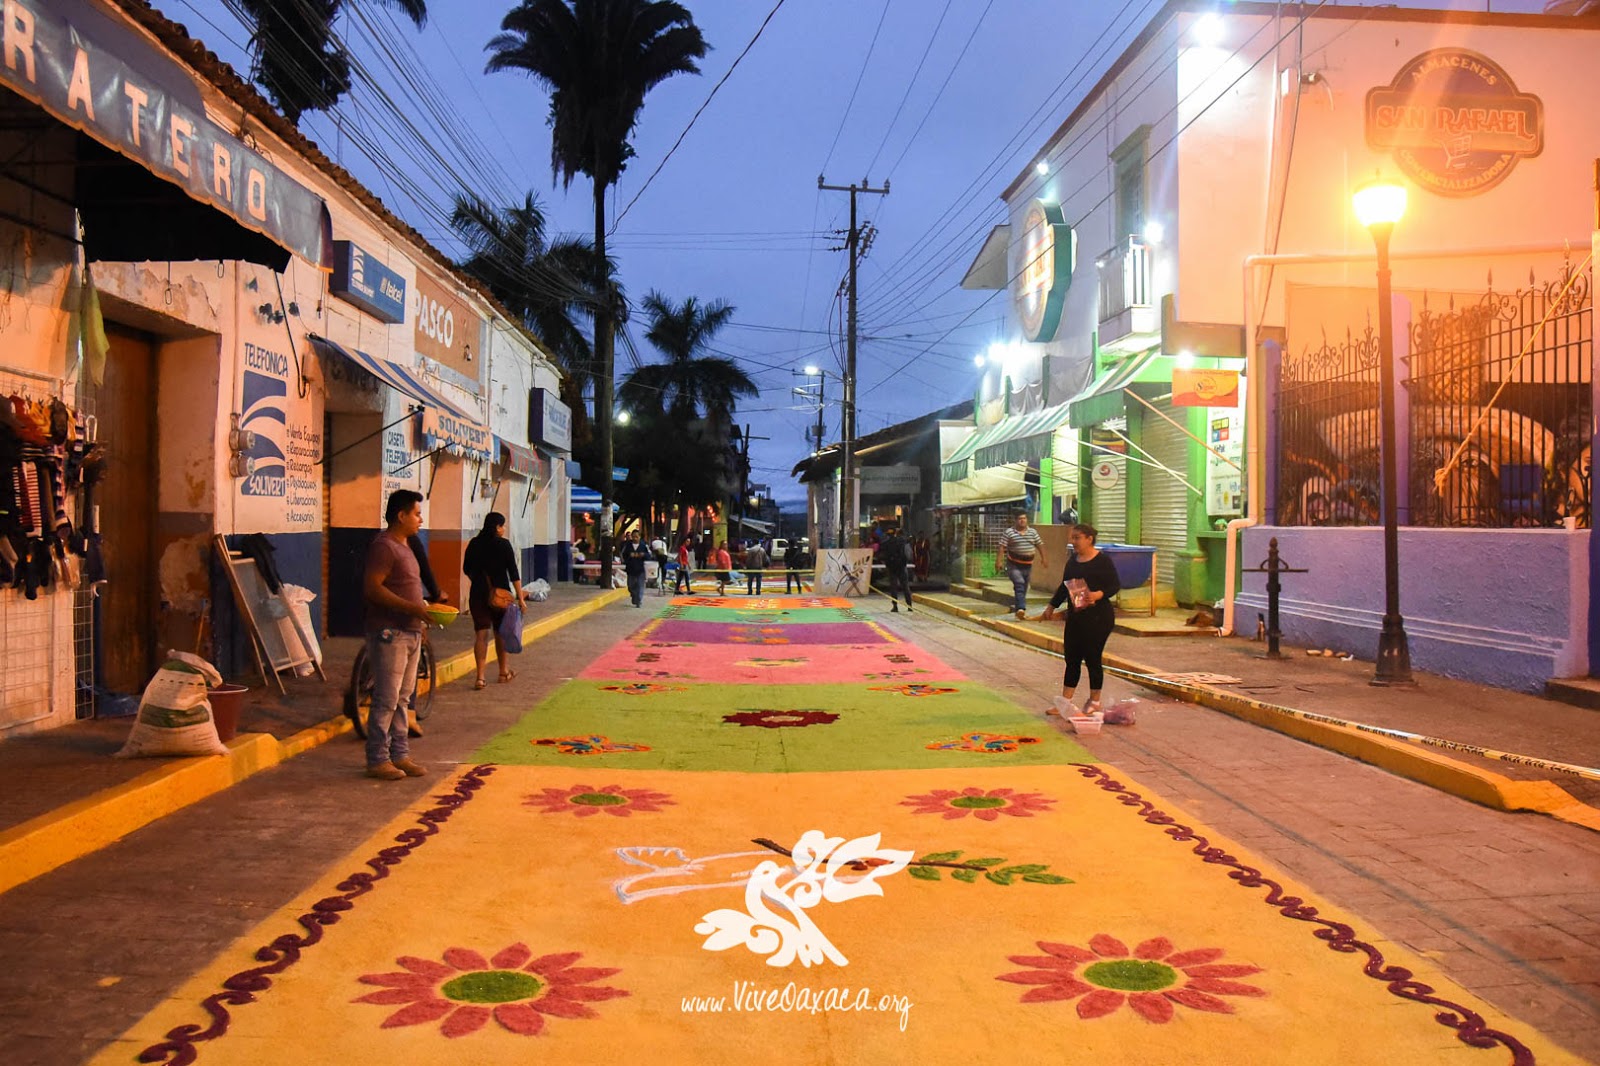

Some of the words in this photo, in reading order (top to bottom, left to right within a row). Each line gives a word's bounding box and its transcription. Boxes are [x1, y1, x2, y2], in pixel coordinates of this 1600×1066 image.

[1412, 56, 1497, 86] ALMACENES
[1376, 105, 1426, 129] SAN
[1436, 106, 1536, 140] RAFAEL
[244, 342, 289, 378] TELEFONICA
